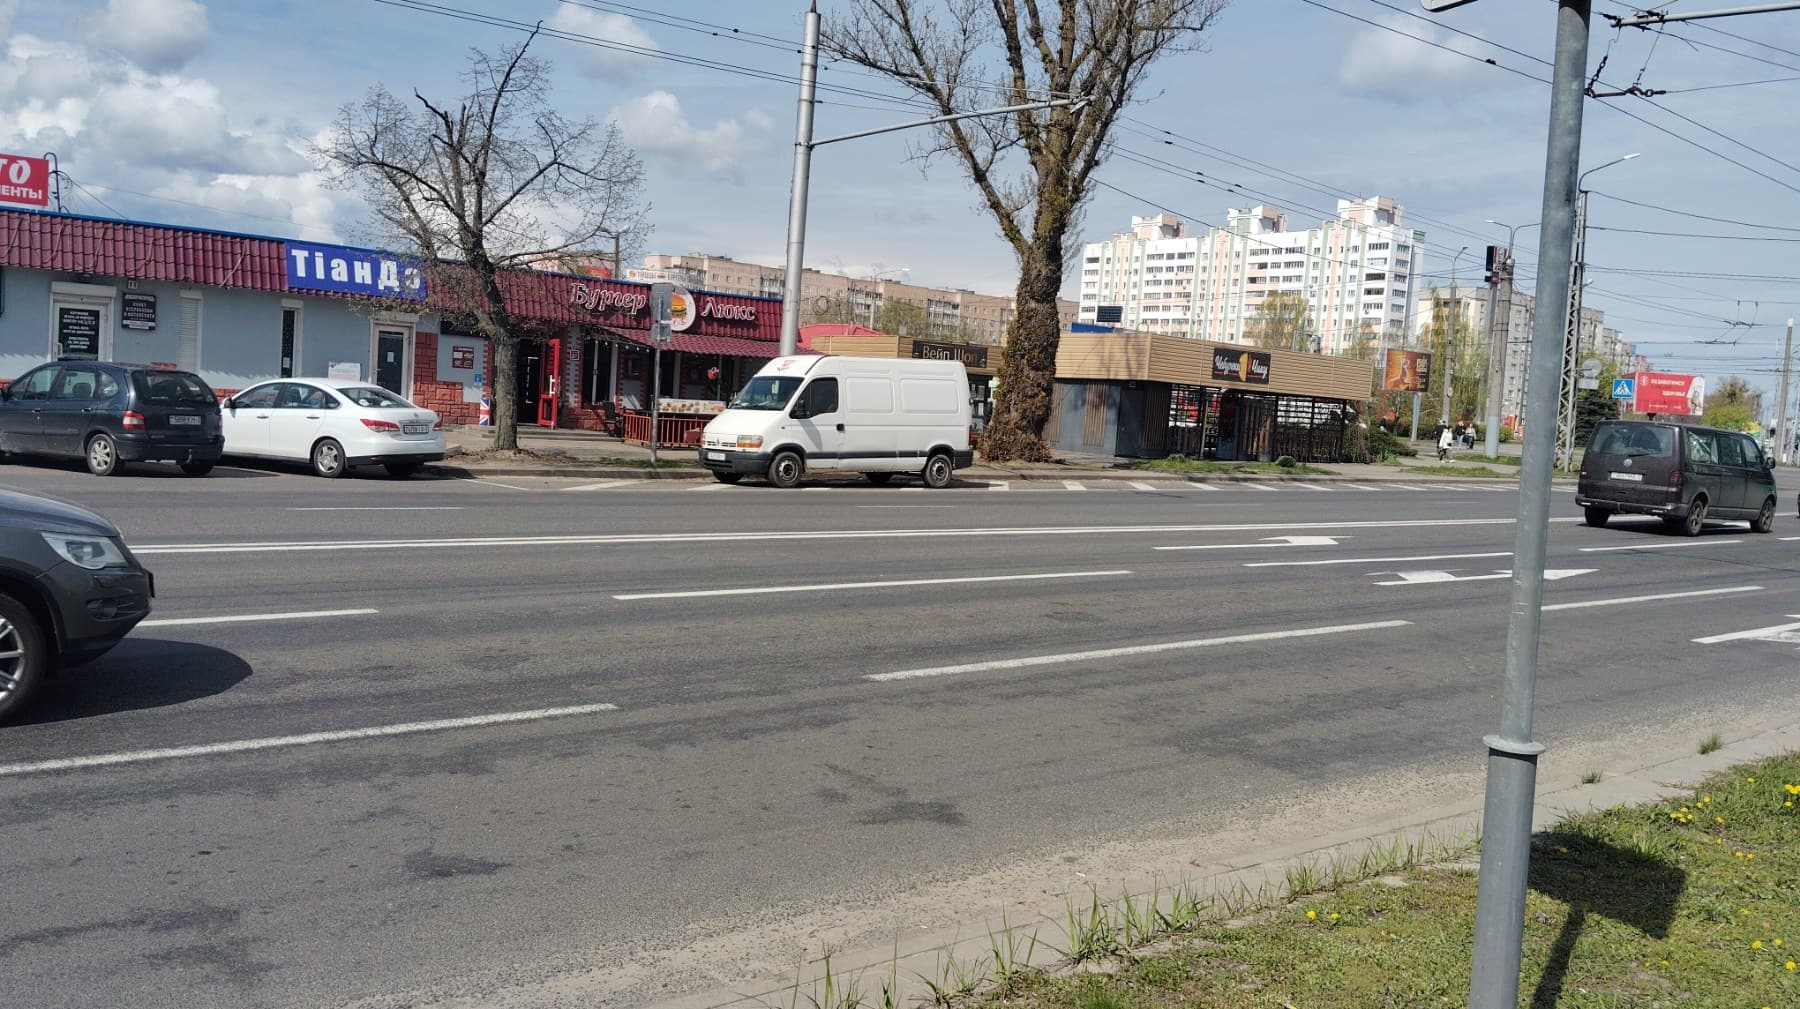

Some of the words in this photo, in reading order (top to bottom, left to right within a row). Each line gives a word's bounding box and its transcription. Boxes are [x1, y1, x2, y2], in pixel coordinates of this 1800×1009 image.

[0, 184, 42, 200] ЕНТЫ
[568, 282, 647, 314] Бургер
[700, 296, 756, 320] Люкс
[922, 345, 950, 361] Вейп
[954, 348, 978, 364] Шоп
